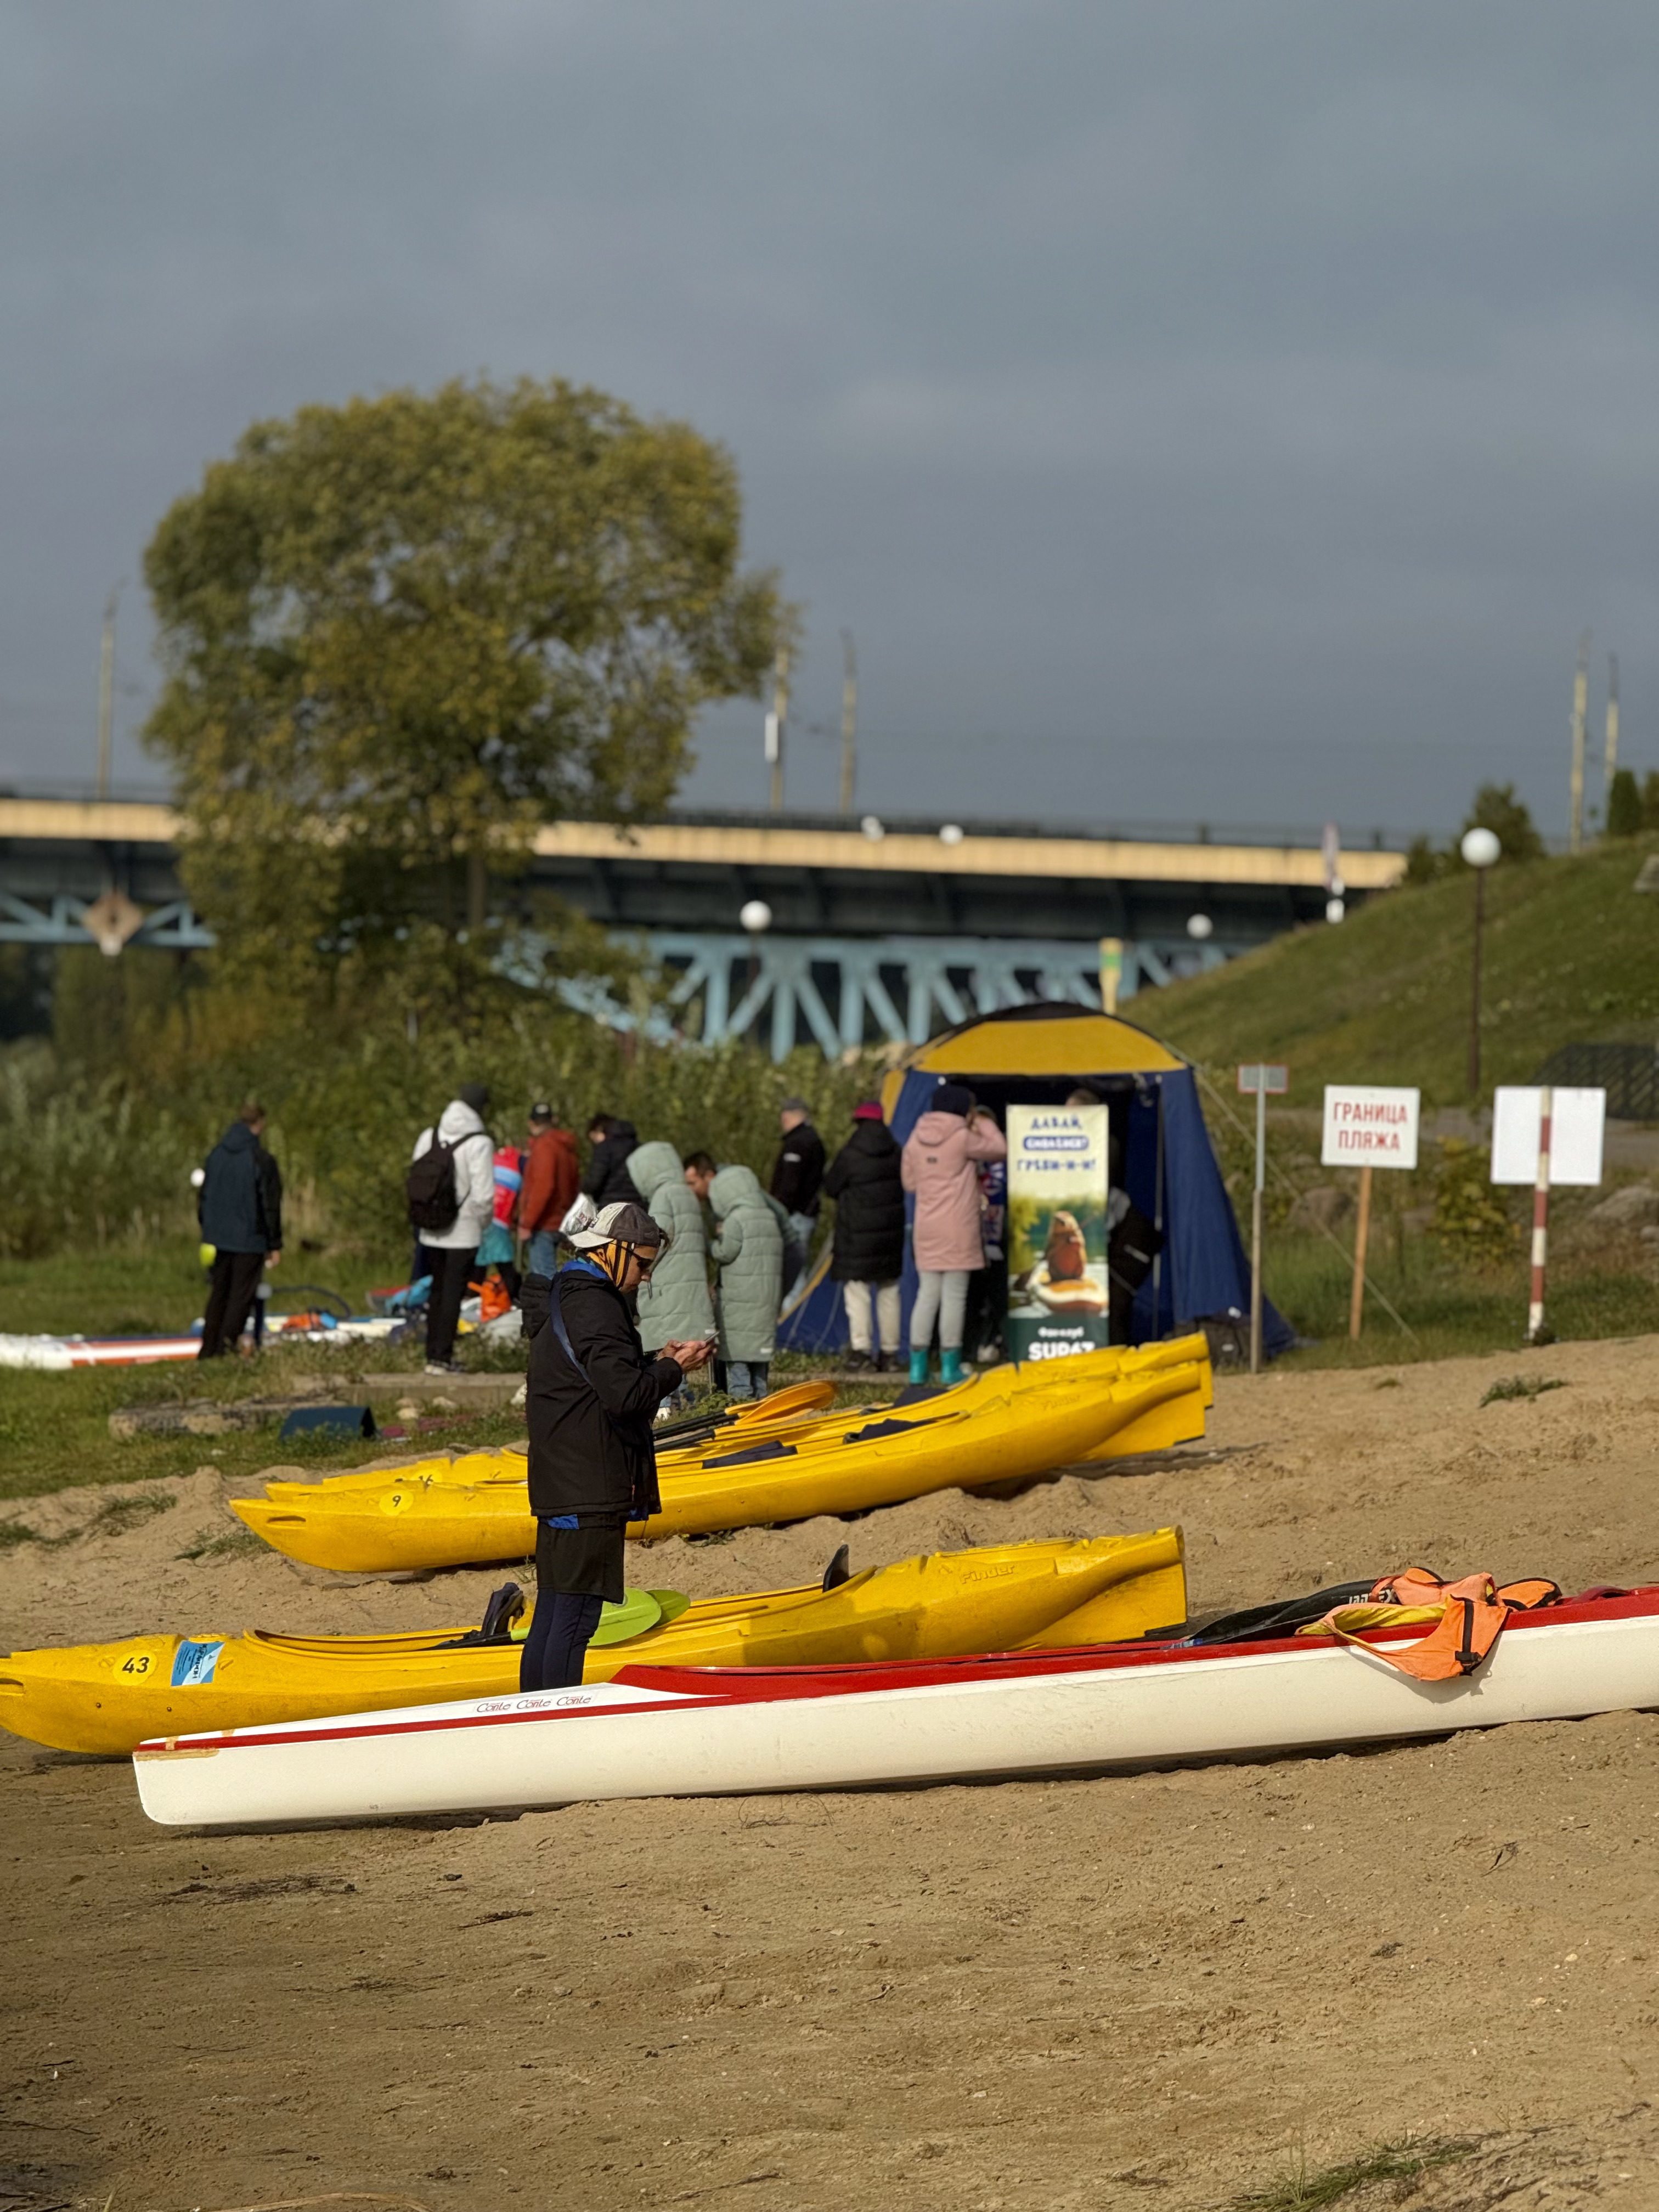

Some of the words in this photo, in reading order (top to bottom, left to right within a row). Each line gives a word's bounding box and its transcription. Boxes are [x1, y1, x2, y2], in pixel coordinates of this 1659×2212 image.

[1334, 1102, 1407, 1125] ГРАНИЦА
[1338, 1130, 1400, 1150] ПЛЯЖА
[392, 1495, 402, 1508] 9
[122, 1656, 150, 1674] 43
